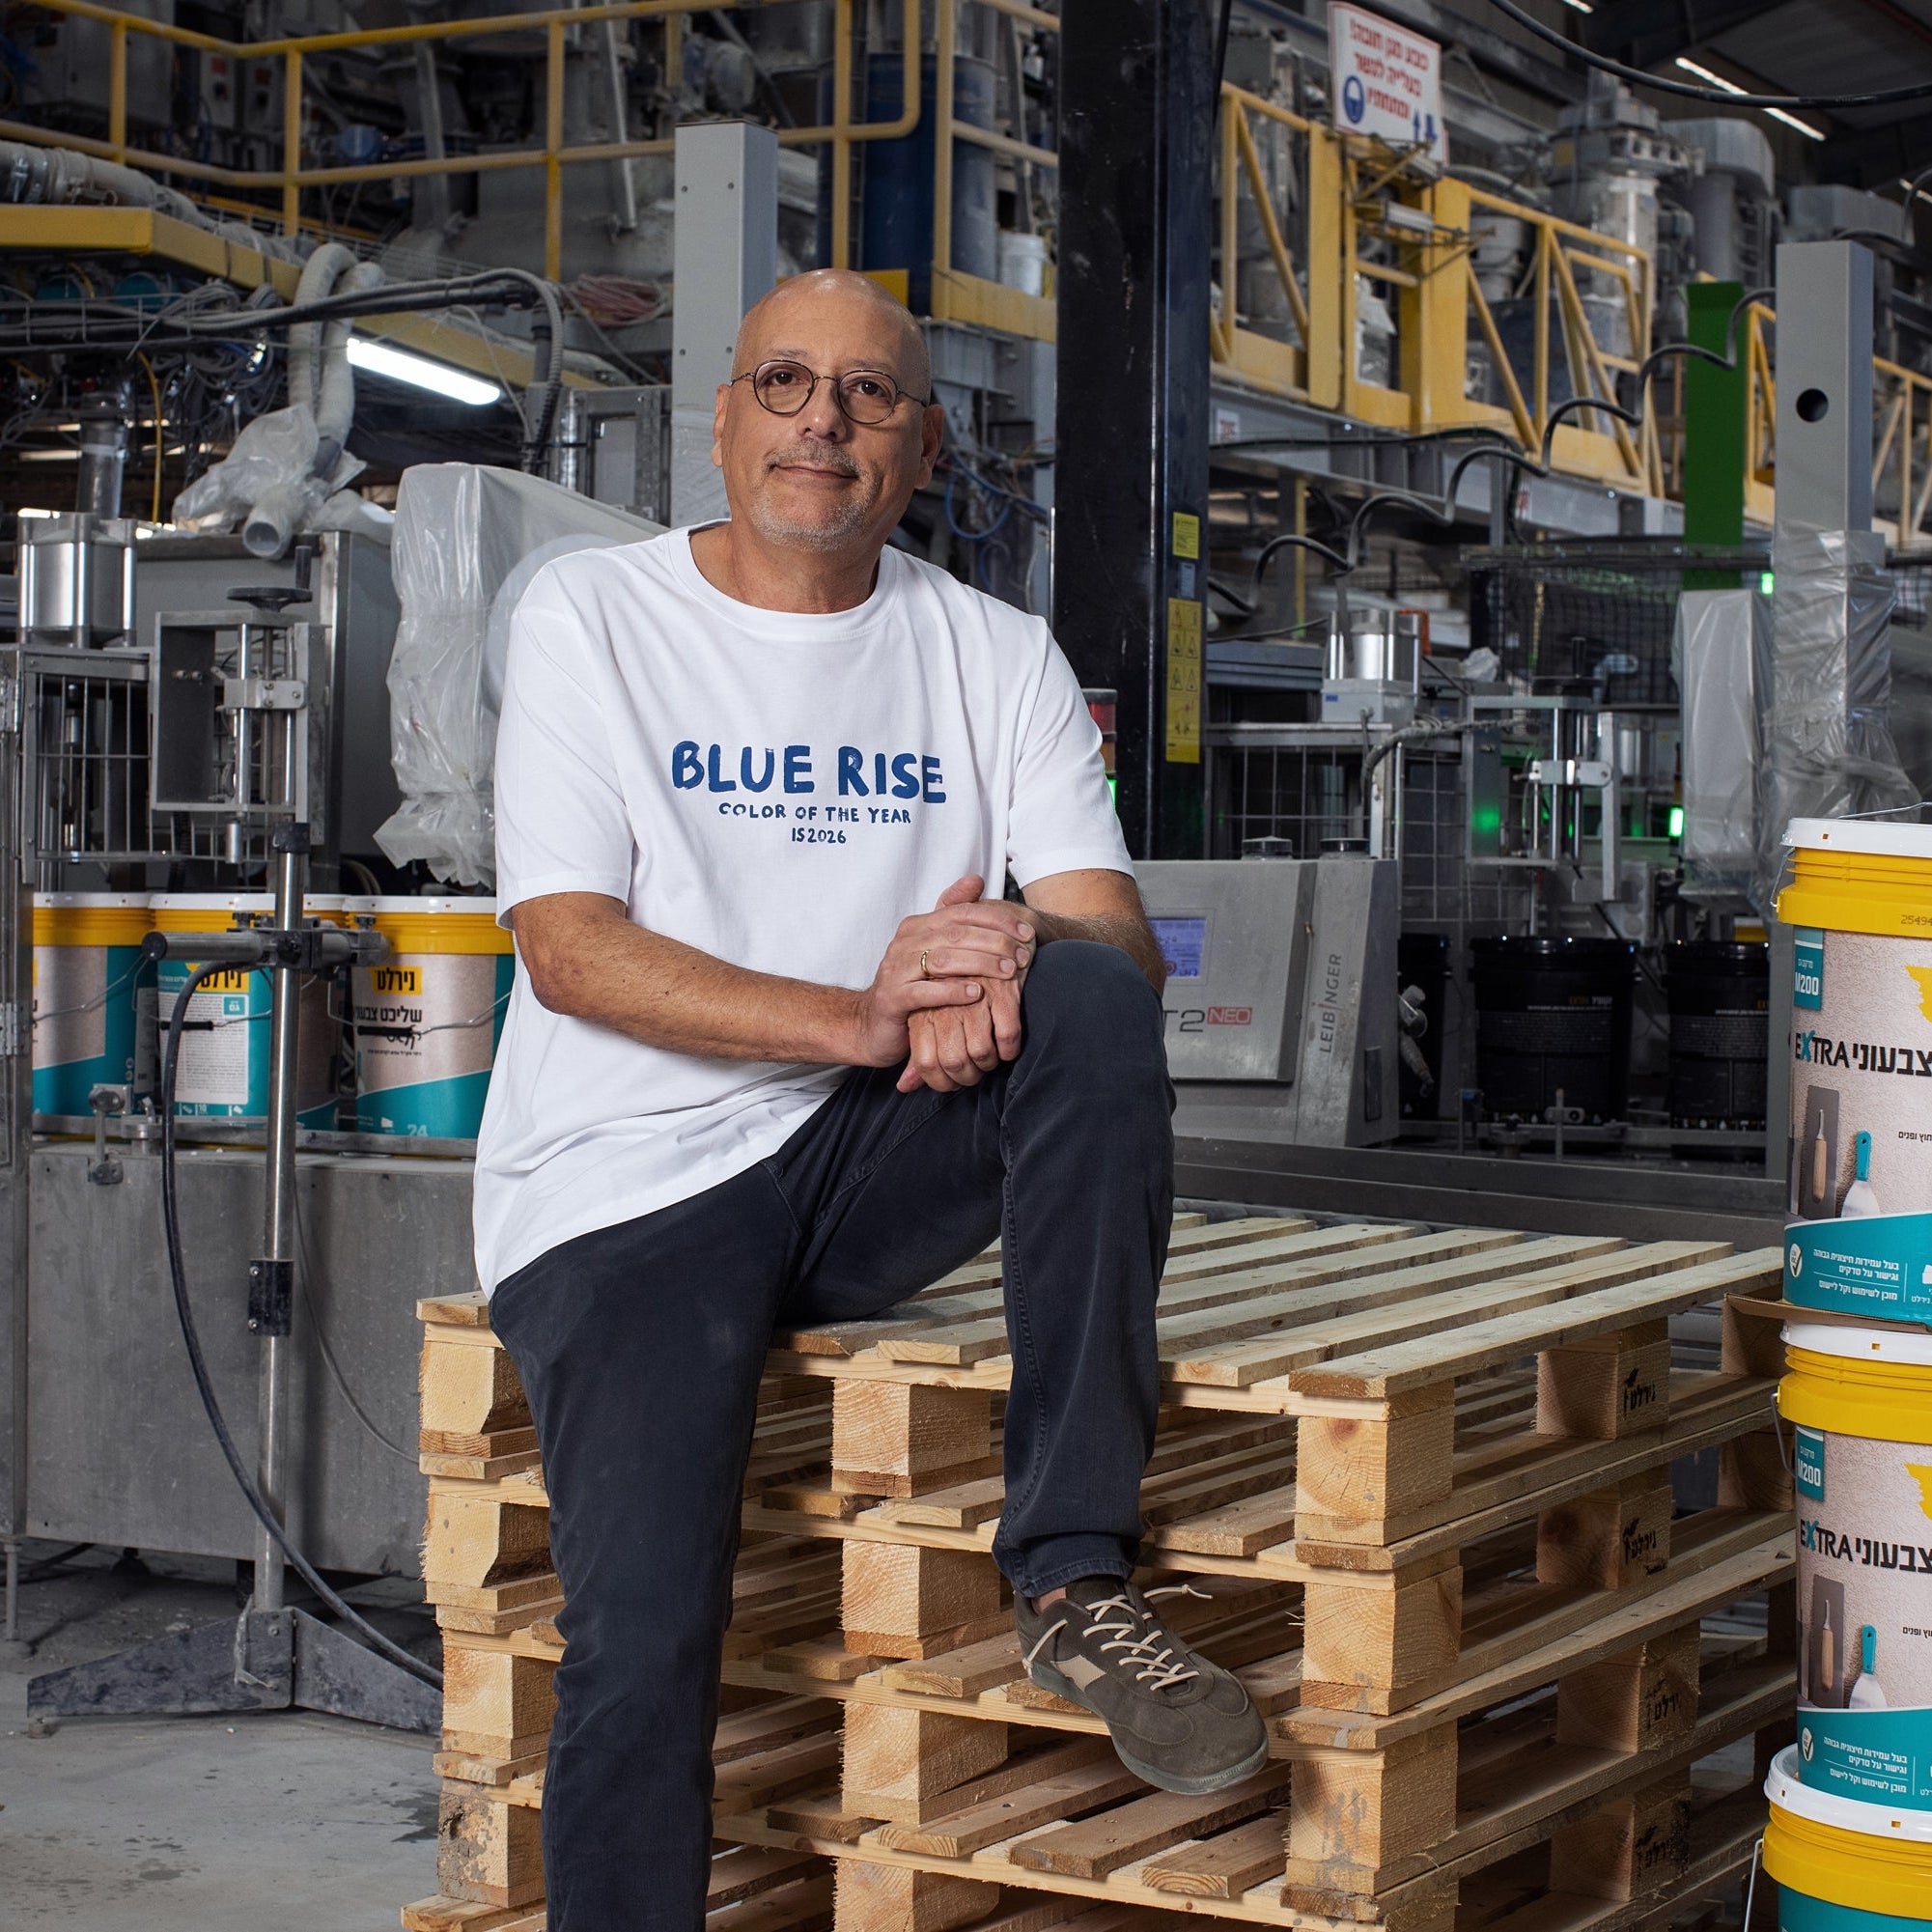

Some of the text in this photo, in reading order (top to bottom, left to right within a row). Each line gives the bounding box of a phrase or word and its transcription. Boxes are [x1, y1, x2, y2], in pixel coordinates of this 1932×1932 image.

[671, 741, 947, 803] BLUE RISE
[718, 802, 911, 824] COLOR OF THE YEAR
[378, 967, 415, 991] נירלט
[1795, 971, 1819, 995] M200
[380, 1005, 423, 1023] שליכט
[1319, 953, 1342, 1053] LEIBINGER
[1208, 1007, 1252, 1024] NEO
[1795, 1029, 1932, 1077] צבעוני EXTRA
[407, 1124, 429, 1136] 24
[1883, 1259, 1899, 1271] בעל
[1798, 1458, 1821, 1487] M200
[1800, 1519, 1932, 1574] צבעוני EXTRA
[1890, 1752, 1908, 1764] בעל
